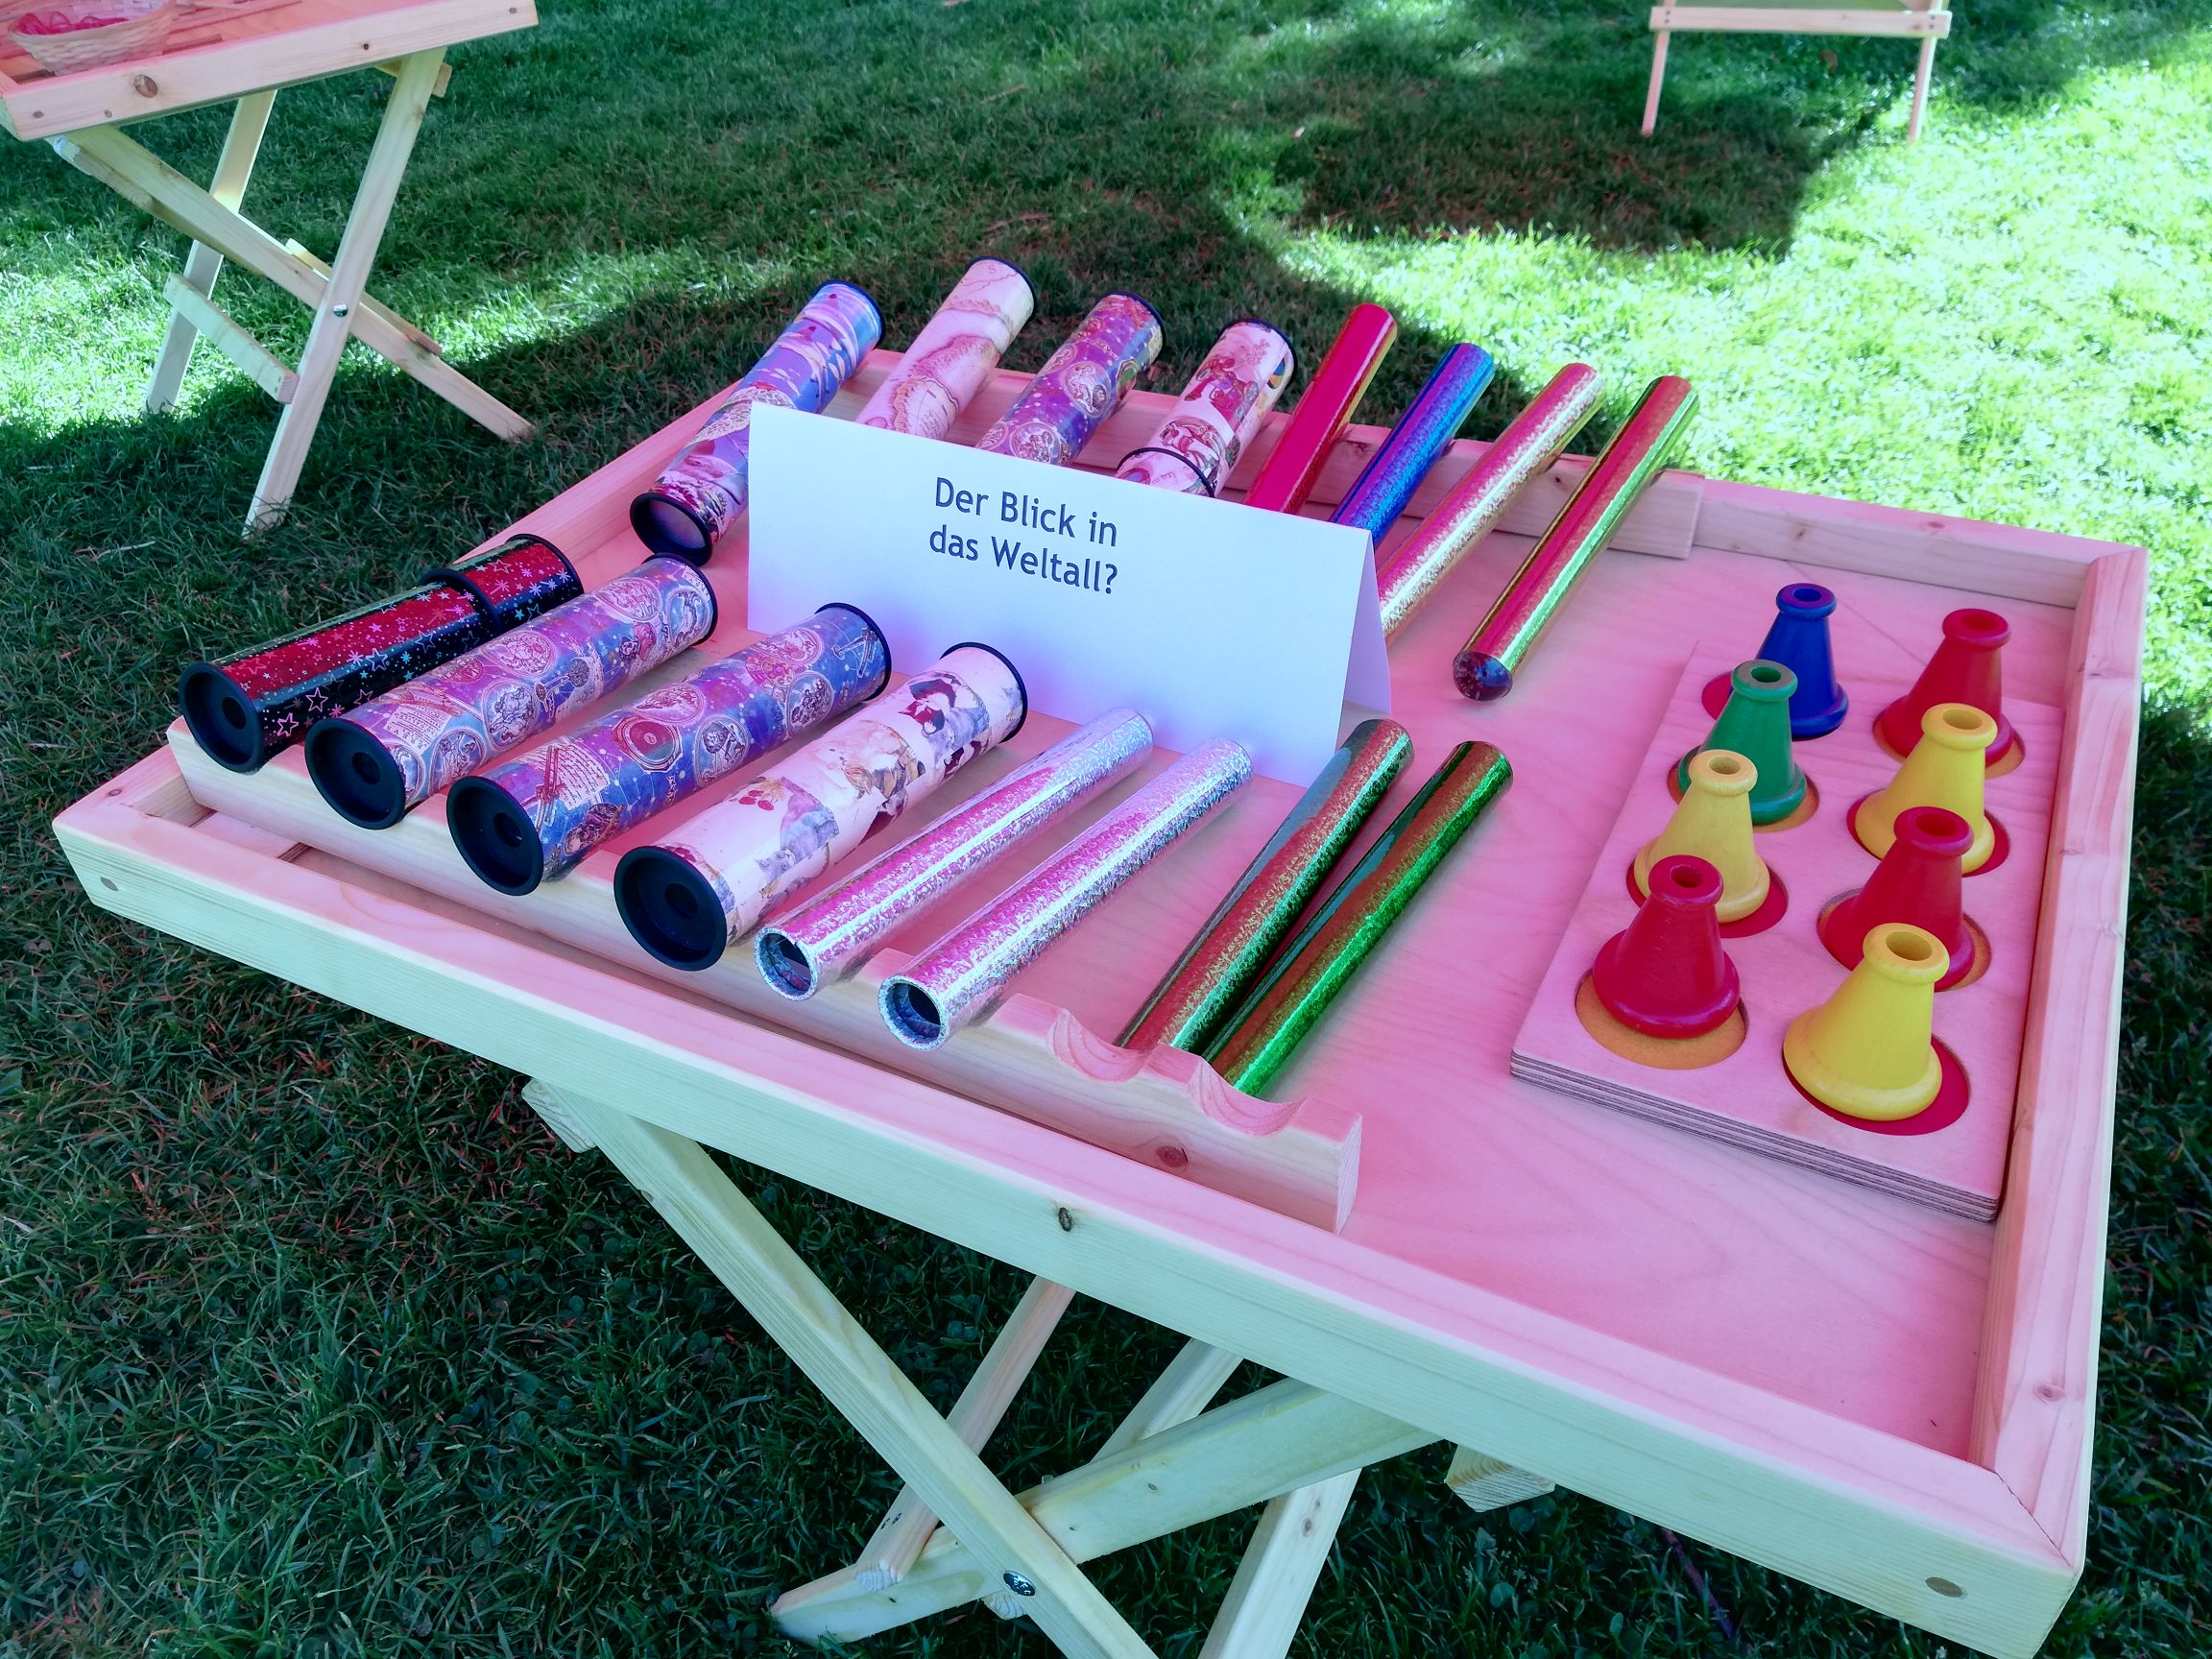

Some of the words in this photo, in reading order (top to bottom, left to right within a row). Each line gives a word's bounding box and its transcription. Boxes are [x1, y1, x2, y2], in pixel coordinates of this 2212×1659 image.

[935, 476, 990, 517] Der
[1000, 491, 1076, 539] Blick
[1089, 511, 1118, 547] in
[929, 523, 979, 562] das
[990, 535, 1118, 595] Weltall?
